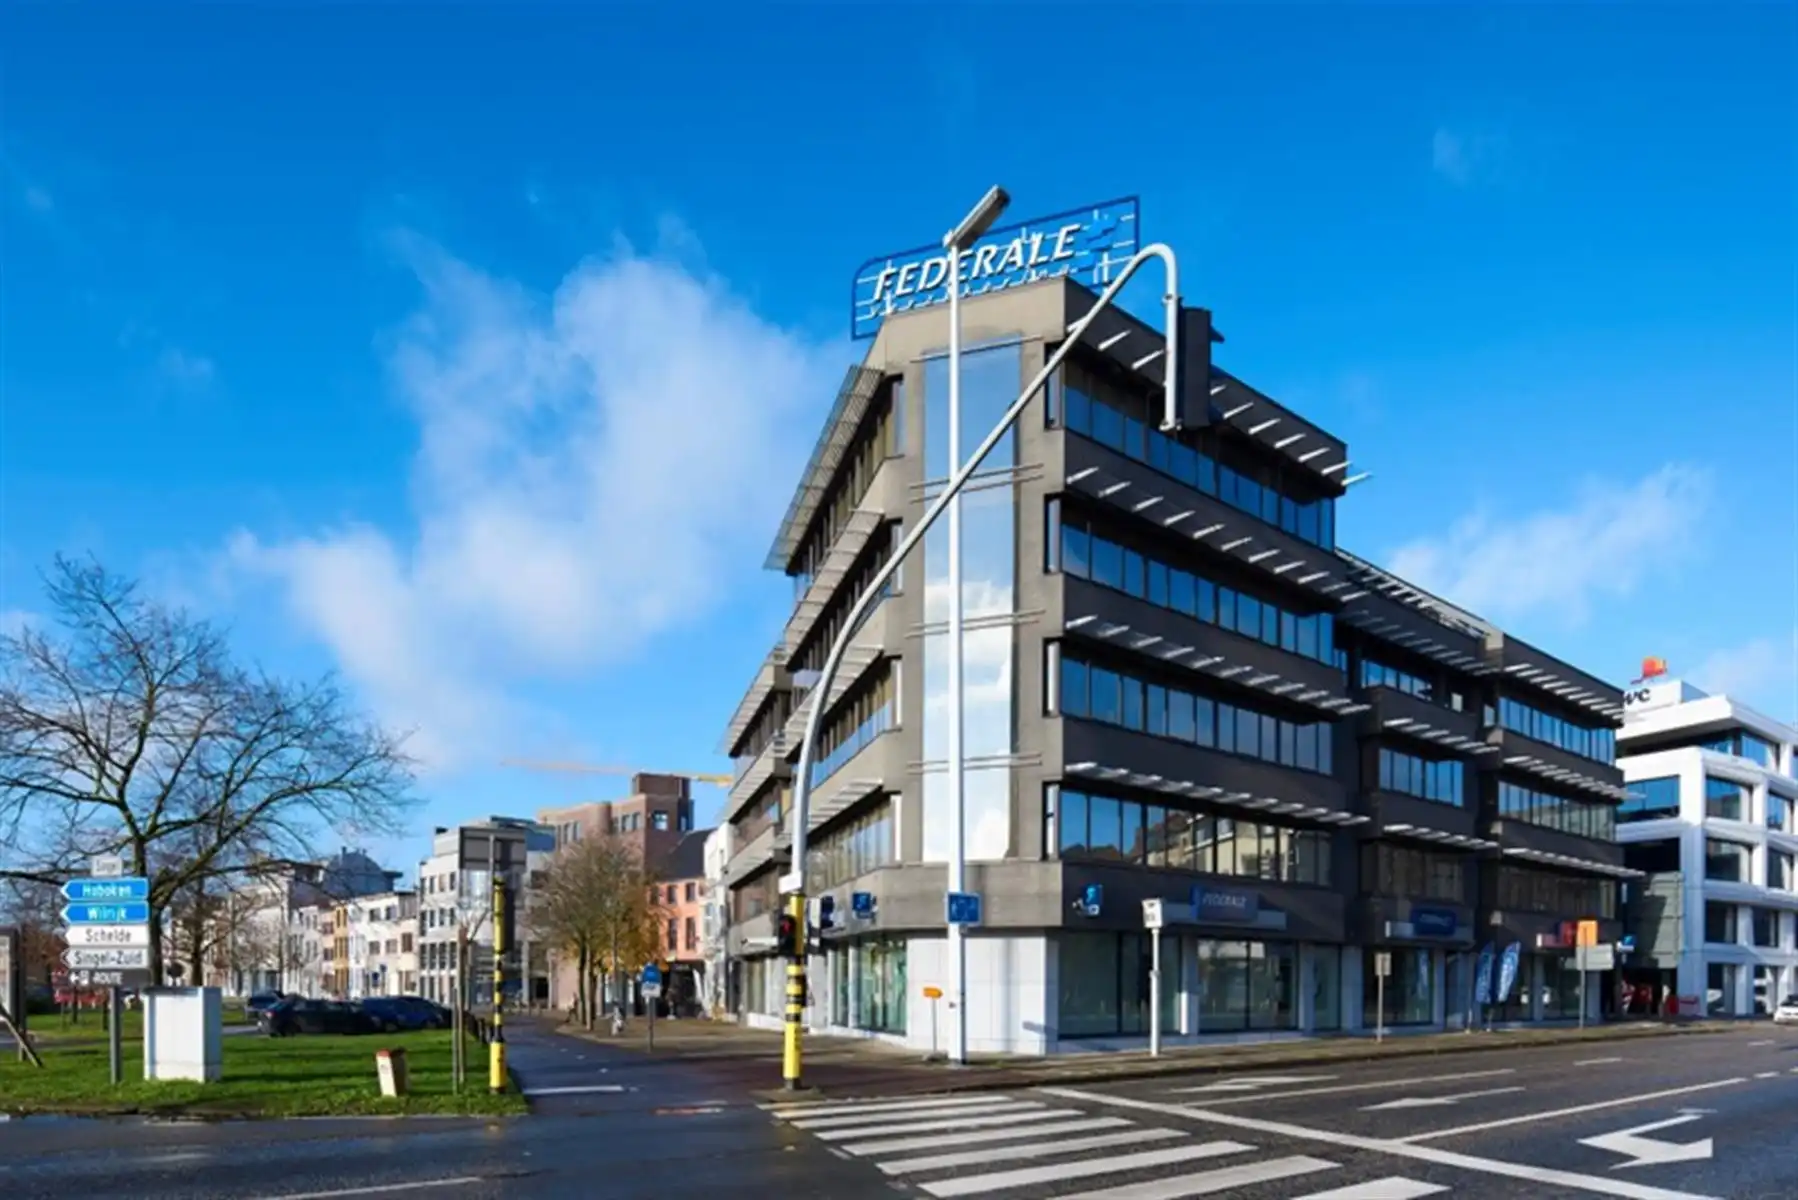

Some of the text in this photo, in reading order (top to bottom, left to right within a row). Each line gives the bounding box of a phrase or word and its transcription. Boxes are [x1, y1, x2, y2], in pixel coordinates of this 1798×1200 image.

[873, 223, 1081, 302] FEDERALE
[82, 884, 132, 897] Hoboken
[85, 929, 132, 943] Schelde
[74, 951, 143, 967] Singel-Zuid
